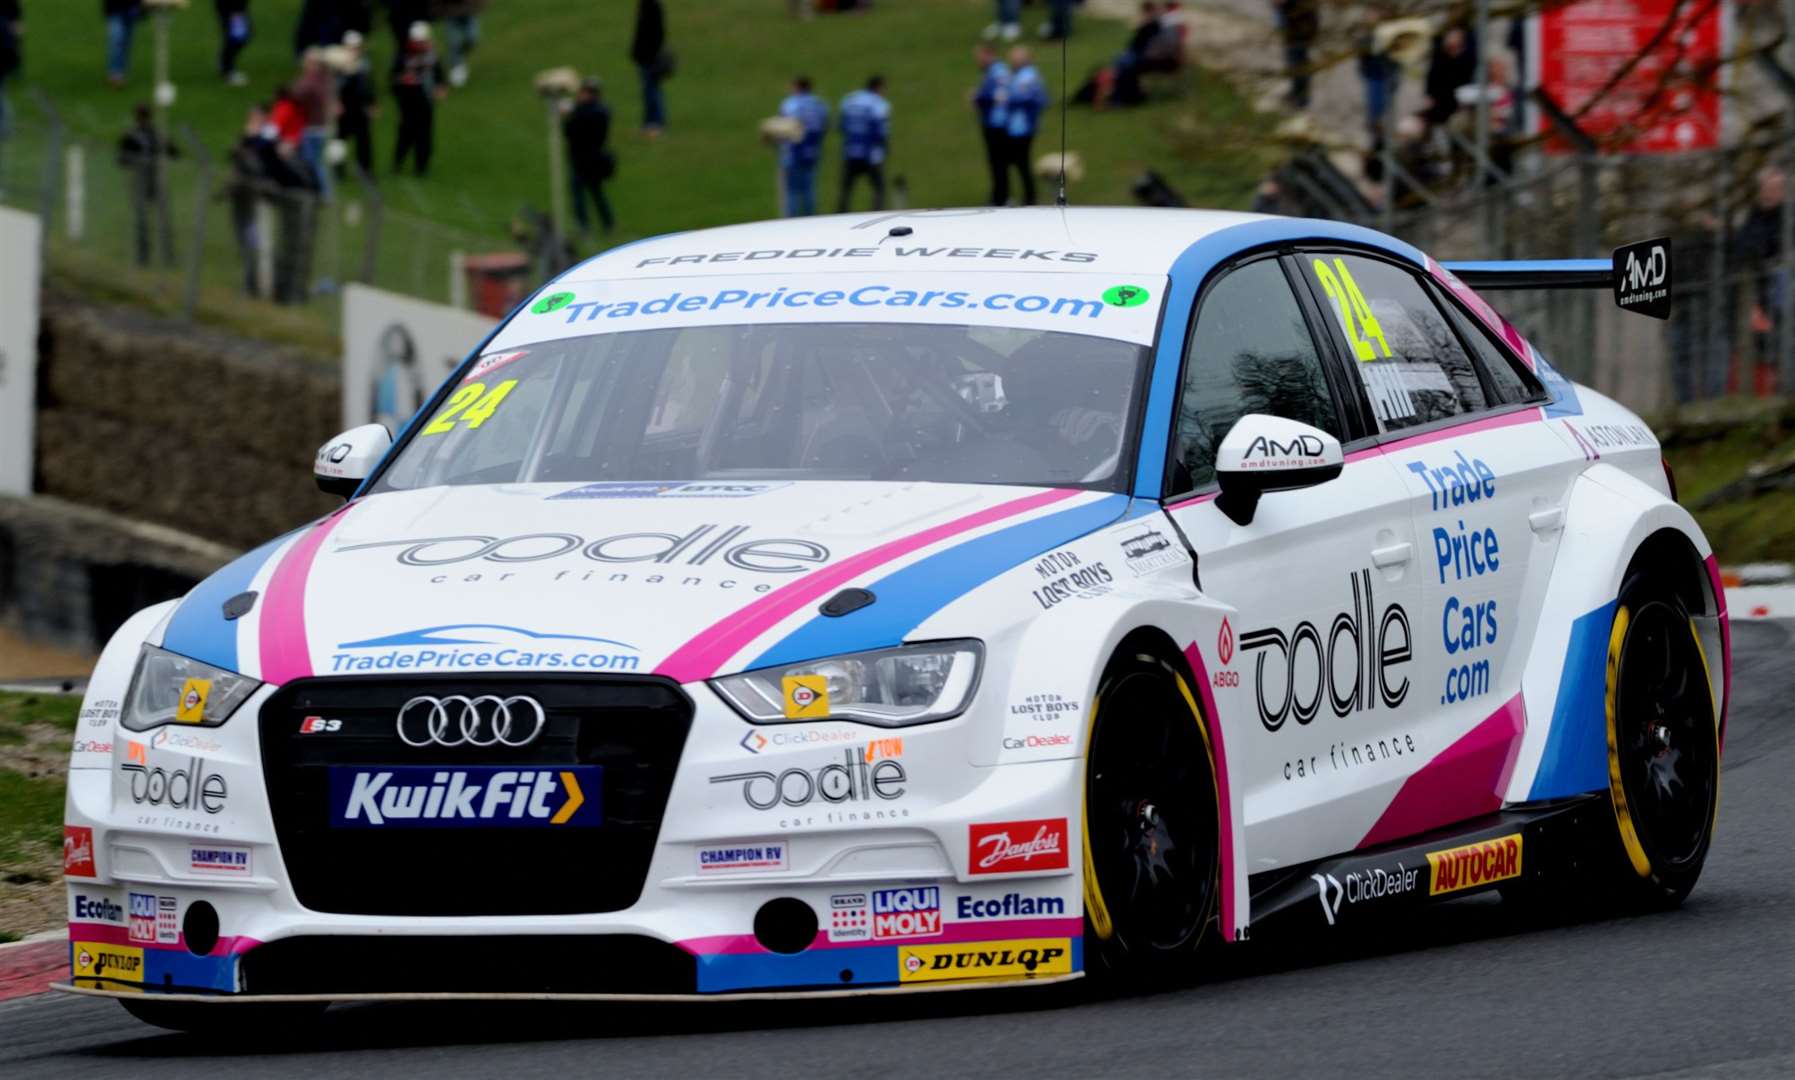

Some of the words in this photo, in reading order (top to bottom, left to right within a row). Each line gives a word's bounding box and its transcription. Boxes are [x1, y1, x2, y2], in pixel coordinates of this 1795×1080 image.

[636, 248, 880, 268] FREDDIE
[894, 247, 1099, 263] WEEKS
[566, 285, 1104, 324] TradePriceCars.com
[1620, 289, 1667, 305] amdtuning.com
[1313, 258, 1392, 361] 24
[421, 380, 519, 436] 24
[1241, 458, 1326, 468] amdtuning.com
[1407, 450, 1496, 511] Trade
[1432, 520, 1499, 584] Price
[1034, 551, 1082, 579] MOTOR
[430, 570, 515, 583] car
[555, 570, 773, 593] finance
[1032, 577, 1079, 611] LOST
[1070, 561, 1114, 590] BOYS
[1443, 596, 1497, 655] Cars
[331, 649, 641, 673] TradePriceCars.com
[1212, 672, 1240, 688] ABGO
[1441, 659, 1490, 705] .com
[1011, 703, 1044, 715] LOST
[1045, 702, 1080, 714] BOYS
[1025, 694, 1063, 704] MOTOR
[309, 719, 342, 732] S3
[1032, 713, 1060, 722] CLUB
[772, 730, 857, 746] ClickDealer
[1003, 734, 1072, 751] CarDealer
[1284, 756, 1316, 781] car
[1330, 733, 1415, 770] finance
[137, 817, 158, 825] car
[163, 816, 221, 833] finance
[779, 816, 814, 828] car
[827, 808, 910, 823] finance
[191, 850, 232, 863] CHAMPION
[701, 848, 763, 864] CHAMPION
[766, 846, 782, 860] RV
[977, 825, 1061, 868] Danfoss
[1434, 838, 1518, 892] AUTOCAR
[1346, 862, 1419, 903] ClickDealer
[833, 896, 865, 906] BRAND
[874, 887, 939, 913] LIQUI
[957, 893, 1064, 919] Ecoflam
[833, 928, 867, 938] identity
[877, 911, 941, 937] MOLY
[98, 952, 140, 972] DUNLOP
[931, 948, 1064, 969] DUNLOP
